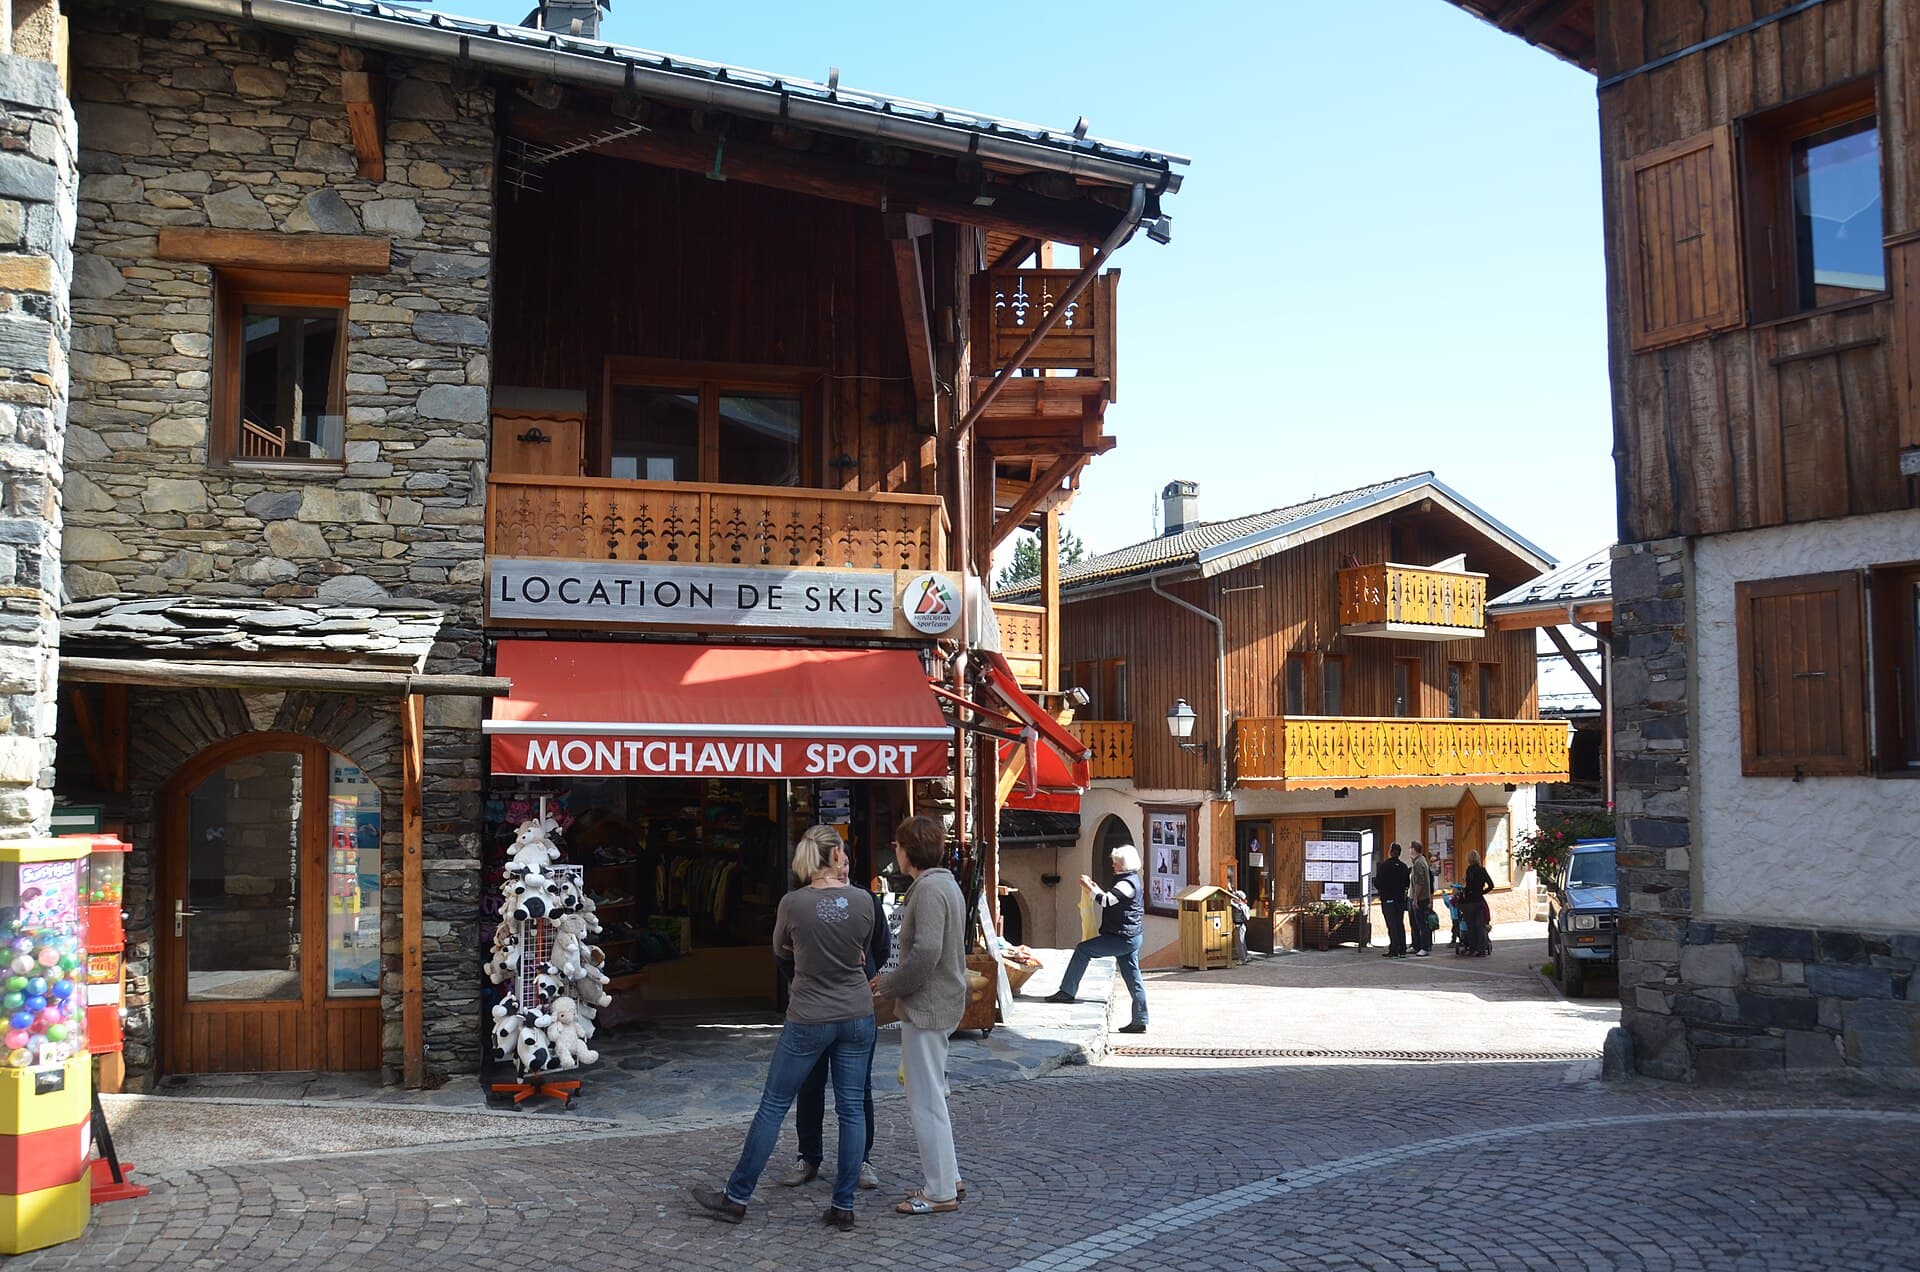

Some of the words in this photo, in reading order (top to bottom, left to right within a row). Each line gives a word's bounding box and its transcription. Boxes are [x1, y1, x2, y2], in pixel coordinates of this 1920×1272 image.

[501, 575, 713, 609] LOCATION
[737, 584, 783, 611] DE
[804, 586, 883, 614] SKIS
[525, 739, 783, 774] MONTCHAVIN
[804, 743, 918, 775] SPORT
